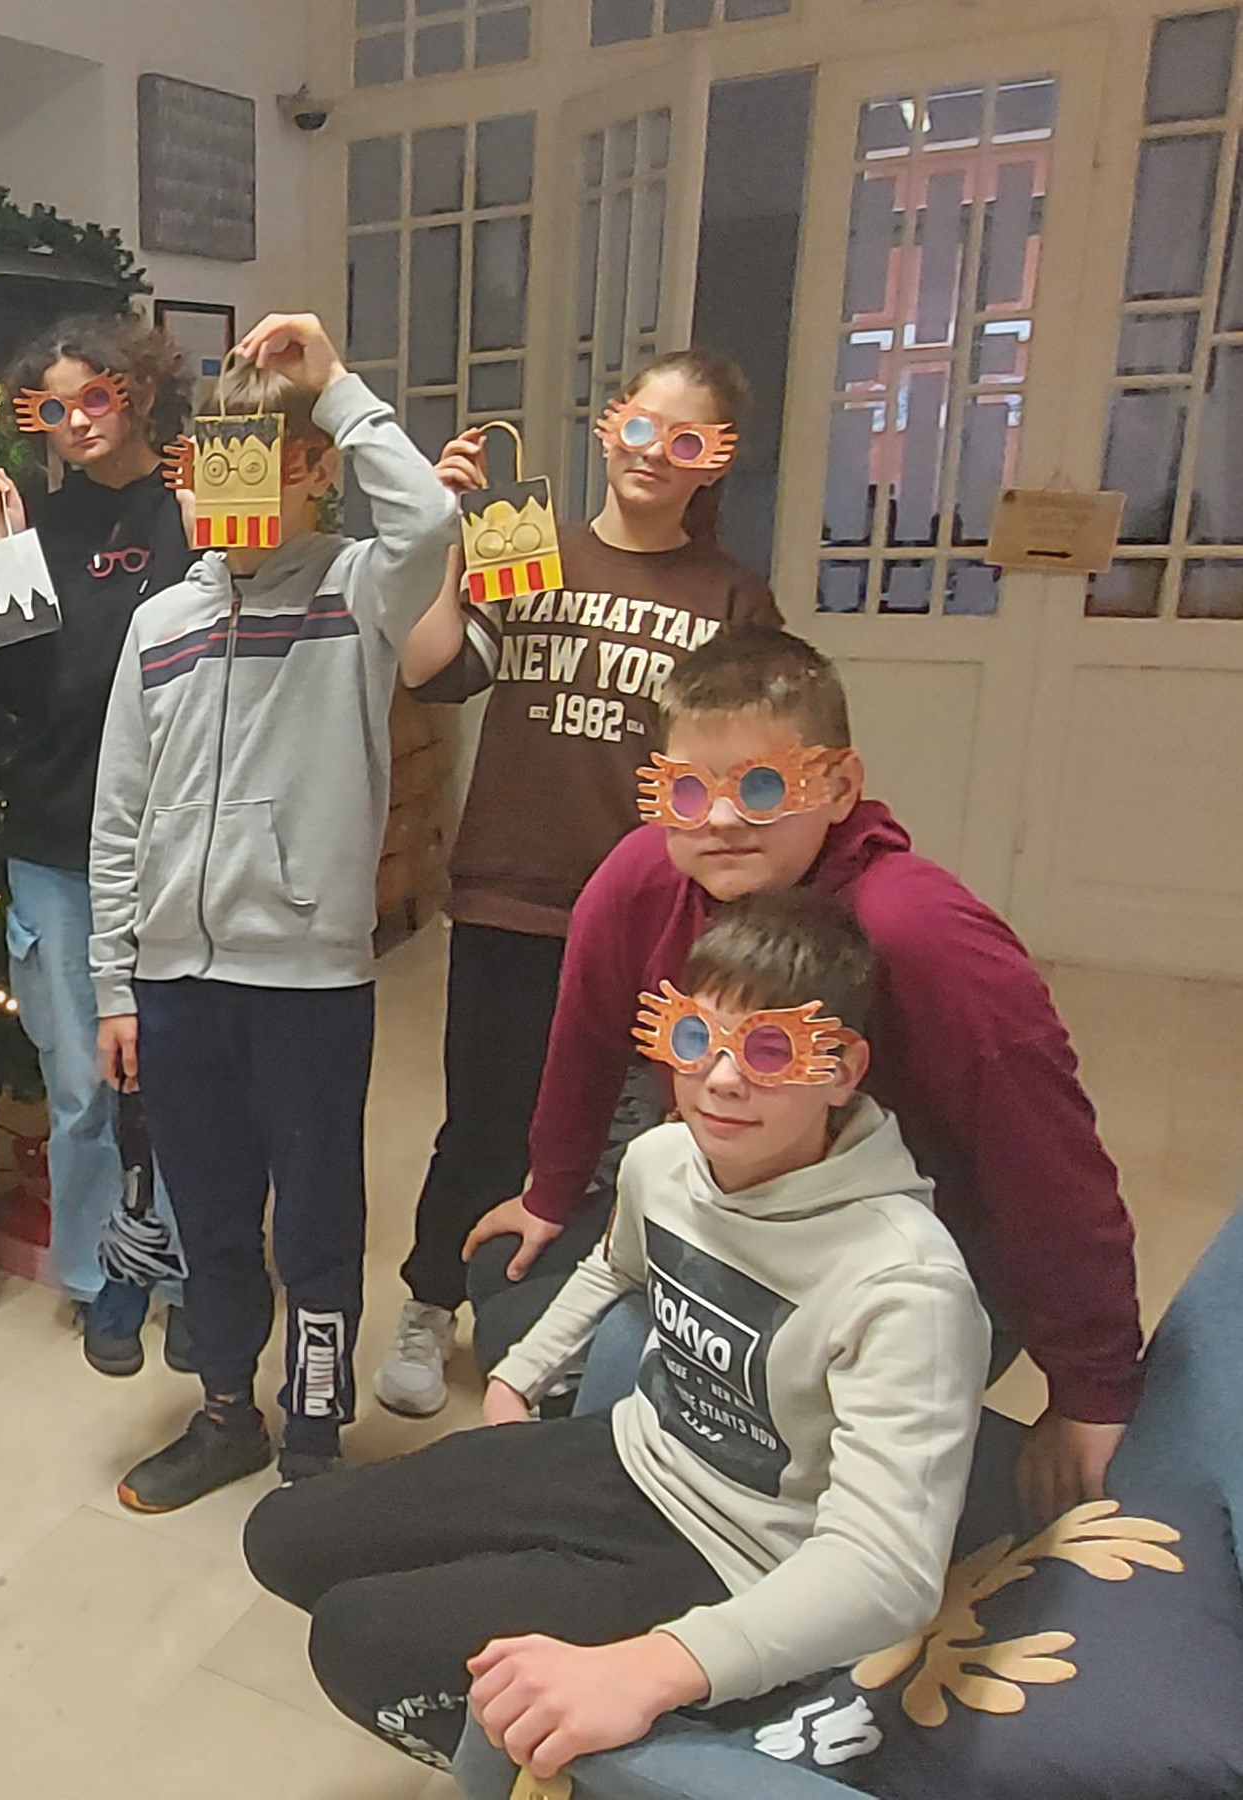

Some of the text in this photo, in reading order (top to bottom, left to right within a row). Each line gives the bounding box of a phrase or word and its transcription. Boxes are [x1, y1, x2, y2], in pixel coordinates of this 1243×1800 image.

[506, 590, 722, 652] MANHATTAN
[497, 634, 676, 704] NEW YOR
[551, 693, 625, 742] 1982
[654, 1280, 732, 1373] tokyo
[305, 1344, 336, 1416] PUMA
[698, 1400, 747, 1434] STARTS
